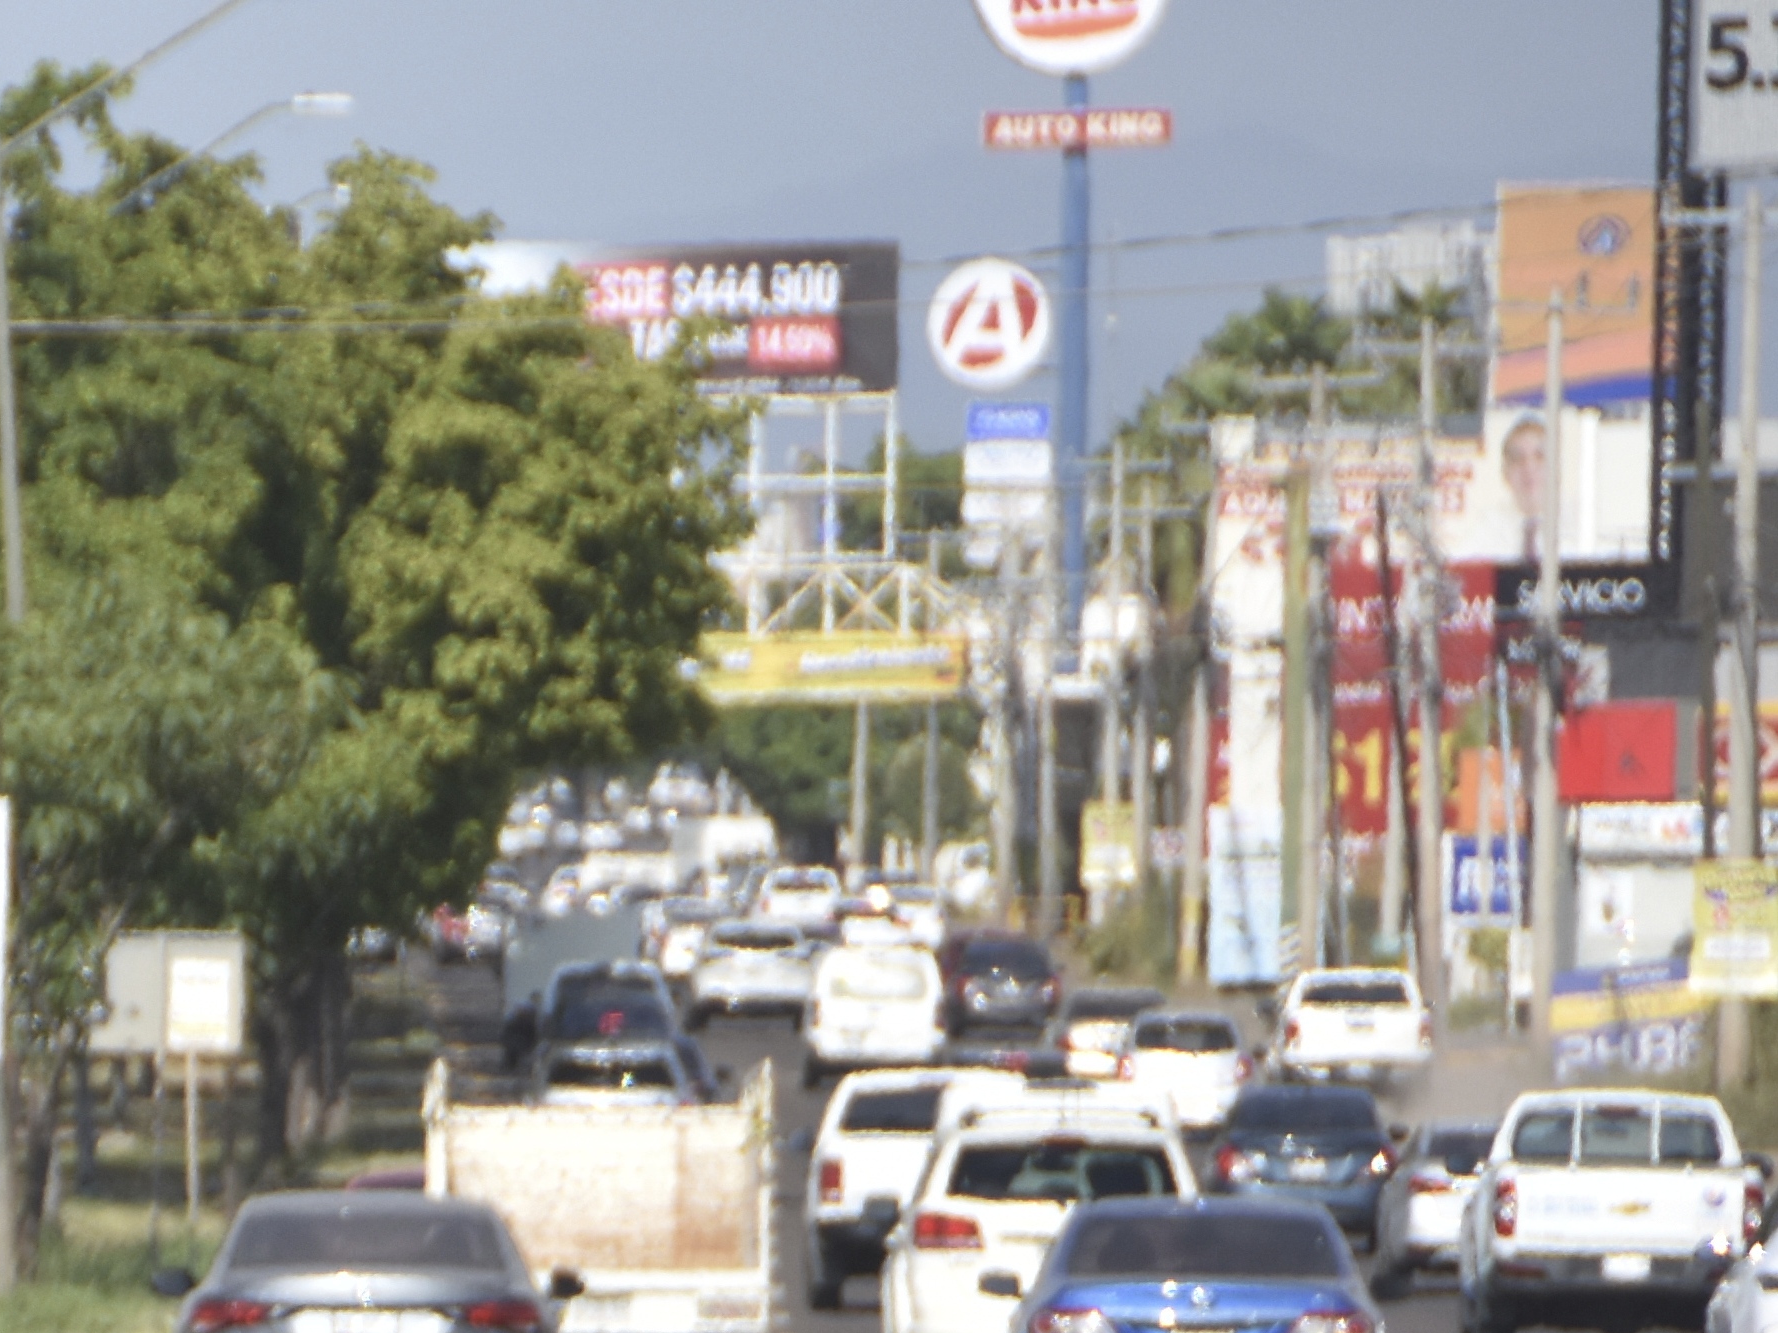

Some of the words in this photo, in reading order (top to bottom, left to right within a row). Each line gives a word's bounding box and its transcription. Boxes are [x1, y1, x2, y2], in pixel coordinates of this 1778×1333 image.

[1705, 13, 1778, 91] 5.
[994, 112, 1077, 142] AUTO
[1086, 109, 1163, 139] KING
[1517, 577, 1647, 614] SVICIO
